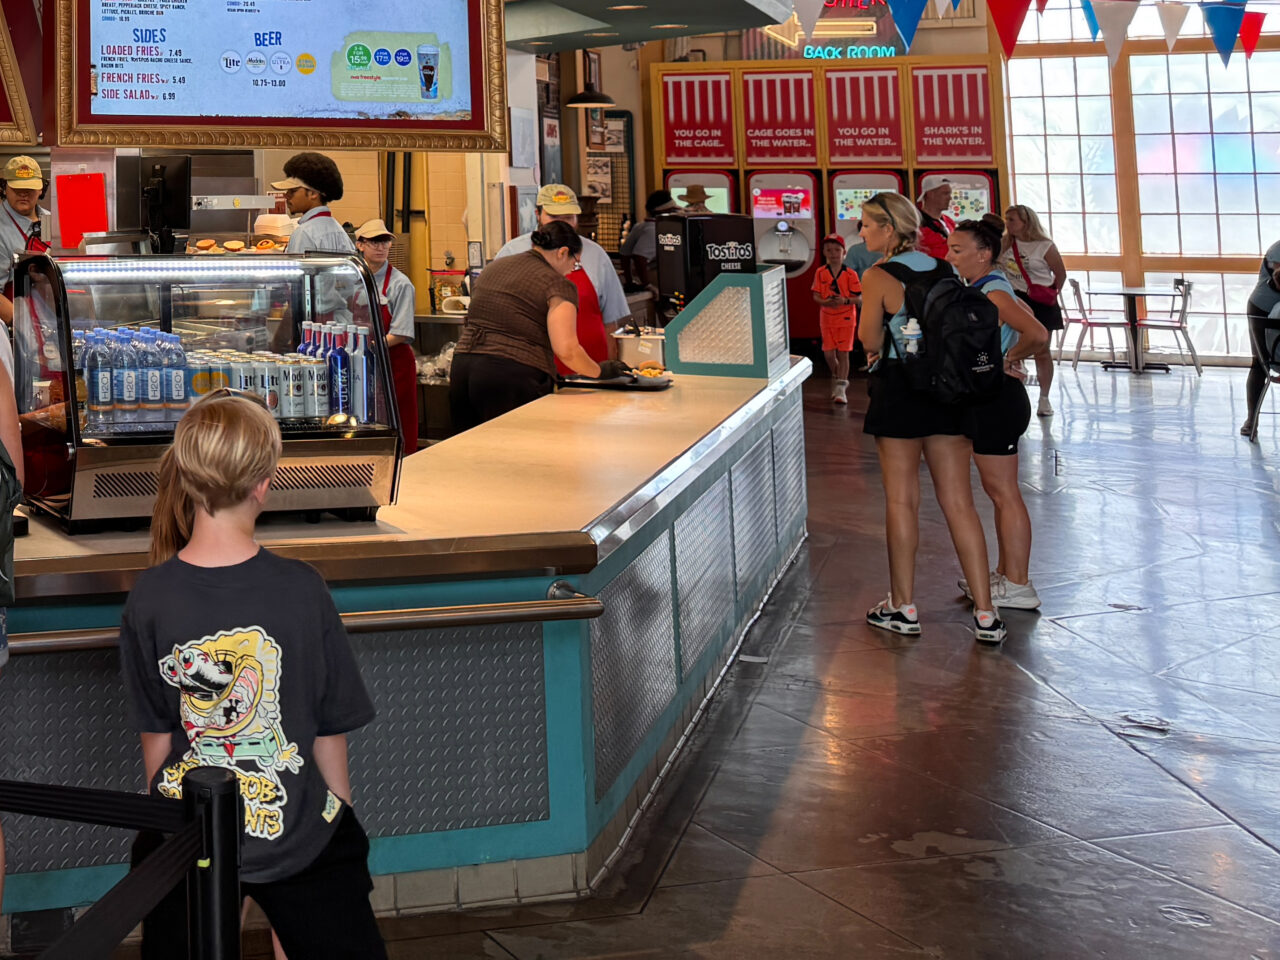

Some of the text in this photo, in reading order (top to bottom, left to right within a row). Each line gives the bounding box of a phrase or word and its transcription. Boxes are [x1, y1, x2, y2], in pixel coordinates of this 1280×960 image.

[133, 28, 166, 43] SIDES
[254, 31, 282, 47] BEER
[101, 45, 133, 55] LOADED
[136, 45, 160, 56] FRIES
[803, 45, 896, 59] BACK ROOM
[225, 58, 240, 68] Lite
[101, 72, 133, 83] FRENCH
[136, 73, 160, 83] FRIES
[101, 88, 120, 99] SIDE
[123, 89, 150, 100] SALAD
[674, 129, 721, 137] YOU GO IN
[747, 129, 774, 137] CAGE
[775, 129, 802, 137] GOES
[838, 127, 889, 136] YOU GO IN
[924, 126, 982, 135] SHARK'S IN
[751, 139, 770, 147] THE
[834, 138, 853, 146] THE
[922, 137, 985, 145] THE WATER.
[707, 242, 752, 259] TOSTITOS
[721, 262, 741, 270] CHEESE
